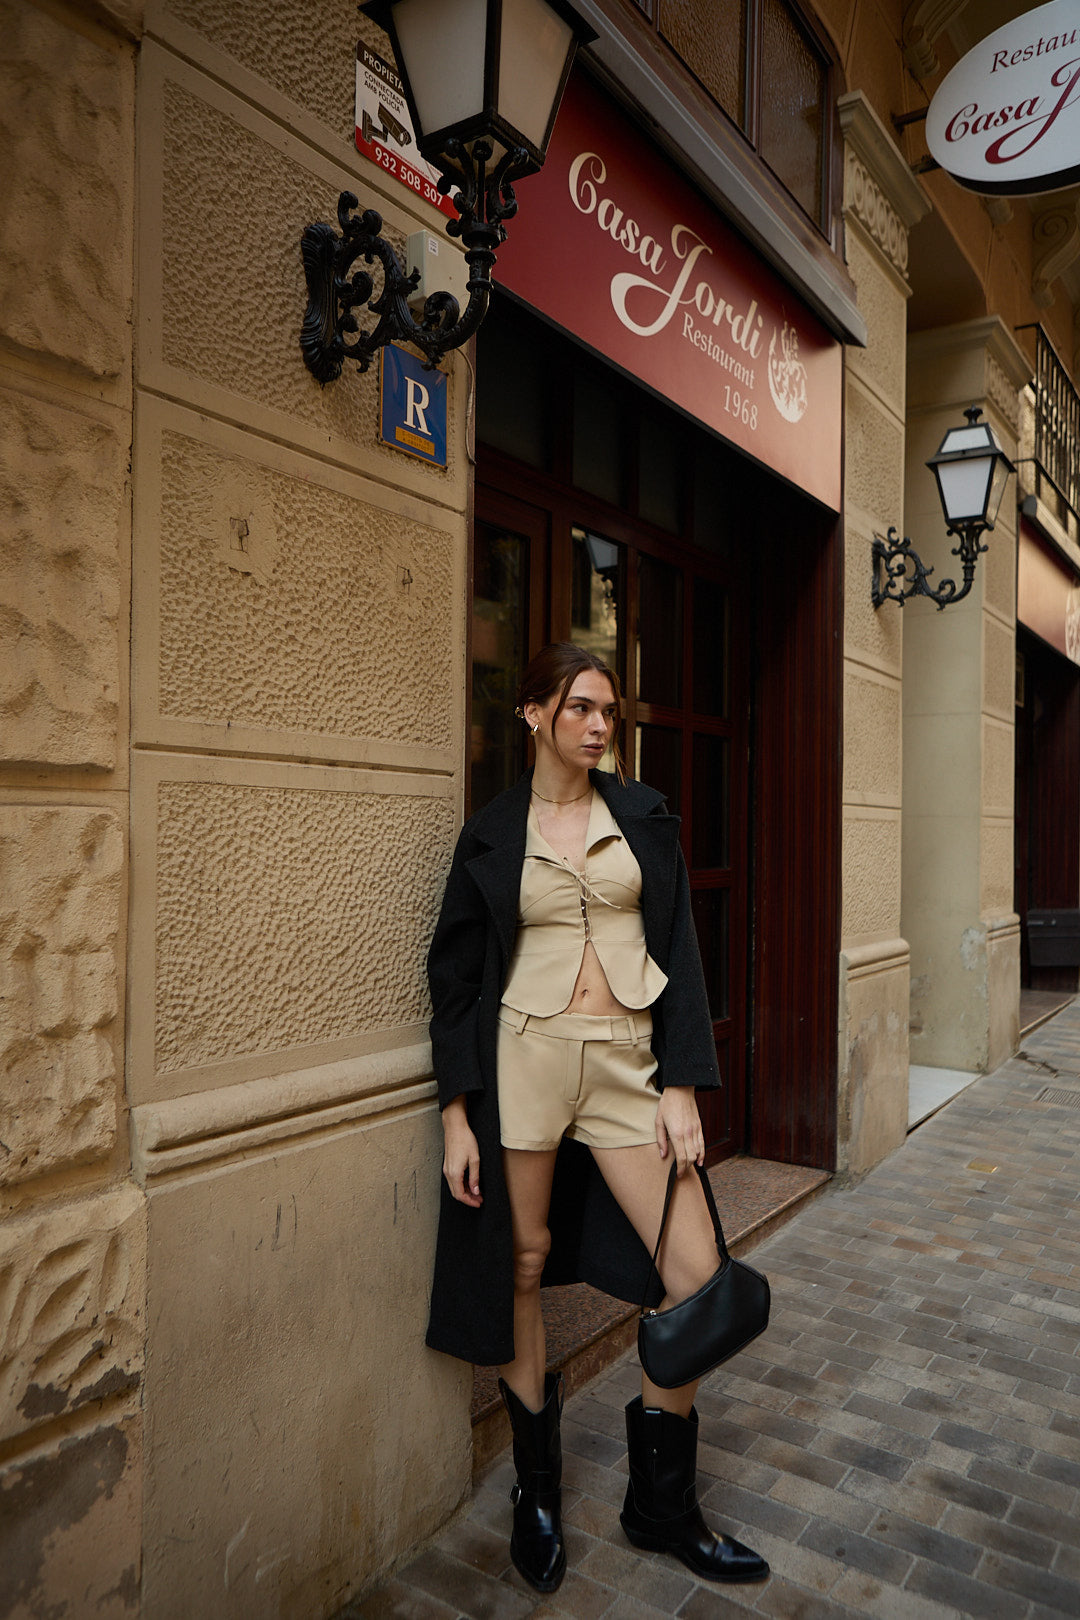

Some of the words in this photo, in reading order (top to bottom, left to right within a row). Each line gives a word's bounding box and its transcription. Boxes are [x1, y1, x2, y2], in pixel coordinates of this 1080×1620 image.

[363, 50, 404, 93] PROPIETA
[990, 29, 1080, 73] Restau
[364, 71, 404, 108] CONNECTADA
[364, 80, 378, 94] AMB
[378, 90, 400, 114] POLICIA
[945, 95, 1046, 142] Casa
[375, 147, 396, 174] 932
[400, 165, 420, 190] 508
[424, 182, 443, 206] 307
[569, 152, 667, 275] Casa
[610, 224, 764, 359] Jordi
[682, 311, 755, 390] Restaurant
[403, 376, 432, 436] R
[723, 385, 758, 430] 1968
